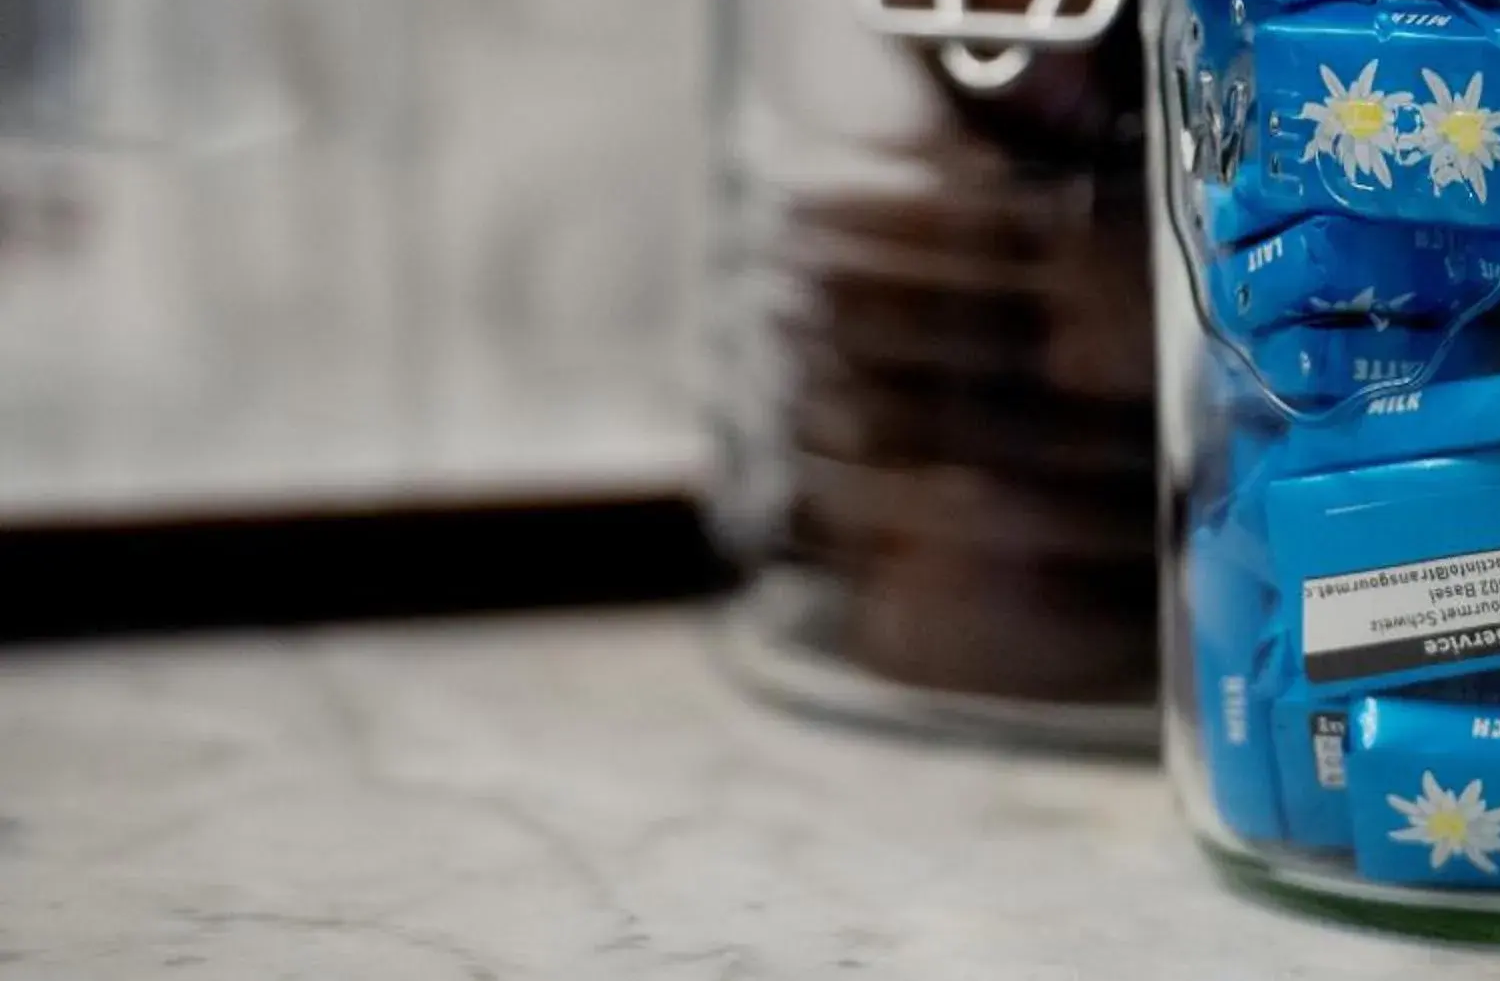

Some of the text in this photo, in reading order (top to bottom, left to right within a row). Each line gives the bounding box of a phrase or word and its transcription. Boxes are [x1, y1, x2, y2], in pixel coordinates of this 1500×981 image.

[1247, 236, 1284, 273] LAIT
[1367, 392, 1422, 415] MILK
[1428, 580, 1478, 604] Basel
[1369, 609, 1439, 633] Schweiz
